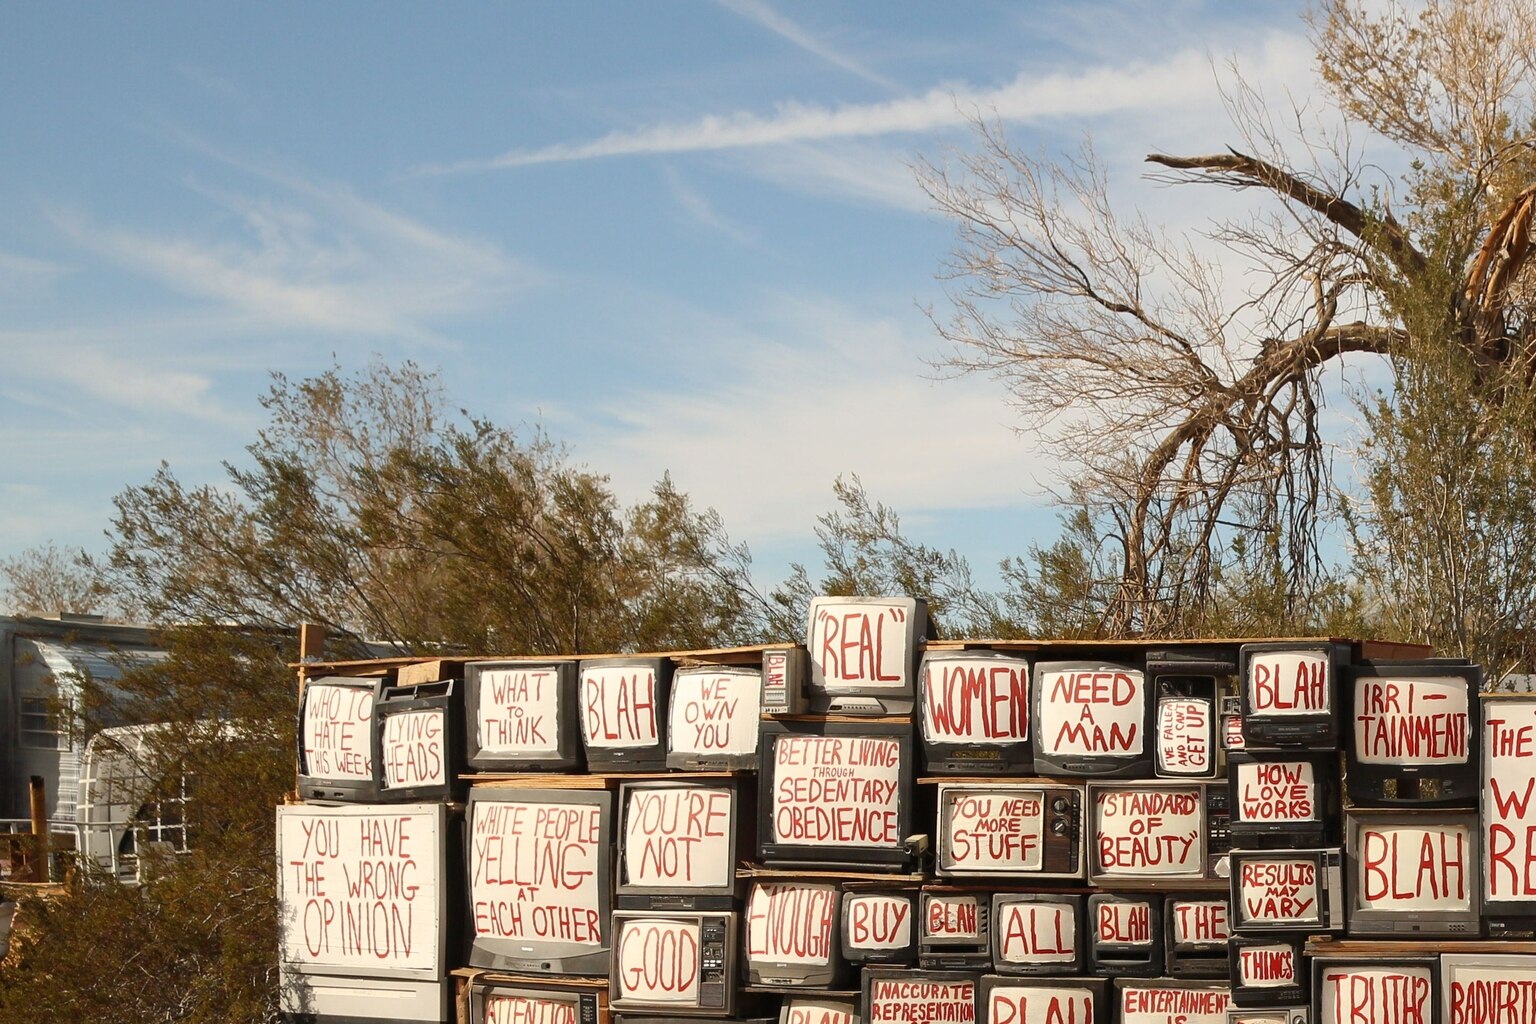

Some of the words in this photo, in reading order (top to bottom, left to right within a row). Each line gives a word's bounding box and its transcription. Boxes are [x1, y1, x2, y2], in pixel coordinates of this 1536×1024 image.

[818, 608, 905, 682] "REAL"
[768, 655, 785, 687] BLAH
[309, 688, 340, 720] WHO
[349, 688, 373, 721] TO
[491, 673, 550, 705] WHAT
[927, 667, 1027, 738] WOMEN
[1050, 673, 1136, 706] NEED
[507, 706, 523, 718] TO
[587, 673, 656, 740] BLAH
[1080, 703, 1095, 725] A
[315, 722, 354, 751] HATE
[389, 714, 441, 744] LYING
[485, 716, 546, 745] THINK
[1054, 721, 1136, 752] MAN
[1487, 719, 1534, 758] THE
[305, 750, 330, 774] THIS
[337, 752, 372, 775] WEEK
[386, 742, 441, 784] HEADS
[778, 738, 842, 767] BETTER
[849, 739, 898, 769] LIVING
[812, 767, 855, 778] THROUGH
[1257, 764, 1303, 785] HOW
[777, 778, 898, 805] SEDENTARY
[952, 795, 992, 820] YOU
[999, 799, 1040, 818] NEED
[1244, 784, 1308, 802] LOVE
[476, 806, 527, 835] WHITE
[535, 808, 600, 844] PEOPLE
[777, 806, 898, 843] OBEDIENCE
[975, 818, 1021, 833] MORE
[1242, 801, 1311, 820] WORKS
[302, 820, 338, 858] YOU
[361, 817, 412, 858] HAVE
[952, 829, 1037, 861] STUFF
[475, 836, 593, 890] YELLING
[1365, 832, 1464, 900] BLAH
[290, 861, 325, 896] THE
[343, 860, 419, 901] WRONG
[517, 888, 539, 902] AT
[304, 899, 412, 959] OPINION
[475, 903, 524, 937] EACH
[532, 906, 600, 942] OTHER
[749, 883, 835, 959] ENOUGH
[852, 901, 909, 943] BUY
[1003, 906, 1074, 955] ALL
[1176, 905, 1228, 940] THE
[619, 927, 697, 992] GOOD
[1240, 951, 1293, 981] THINGS
[873, 981, 974, 1000] INACCURATE
[1124, 990, 1230, 1015] ENTERTAINMENT
[872, 1001, 975, 1023] REPRESENTATION
